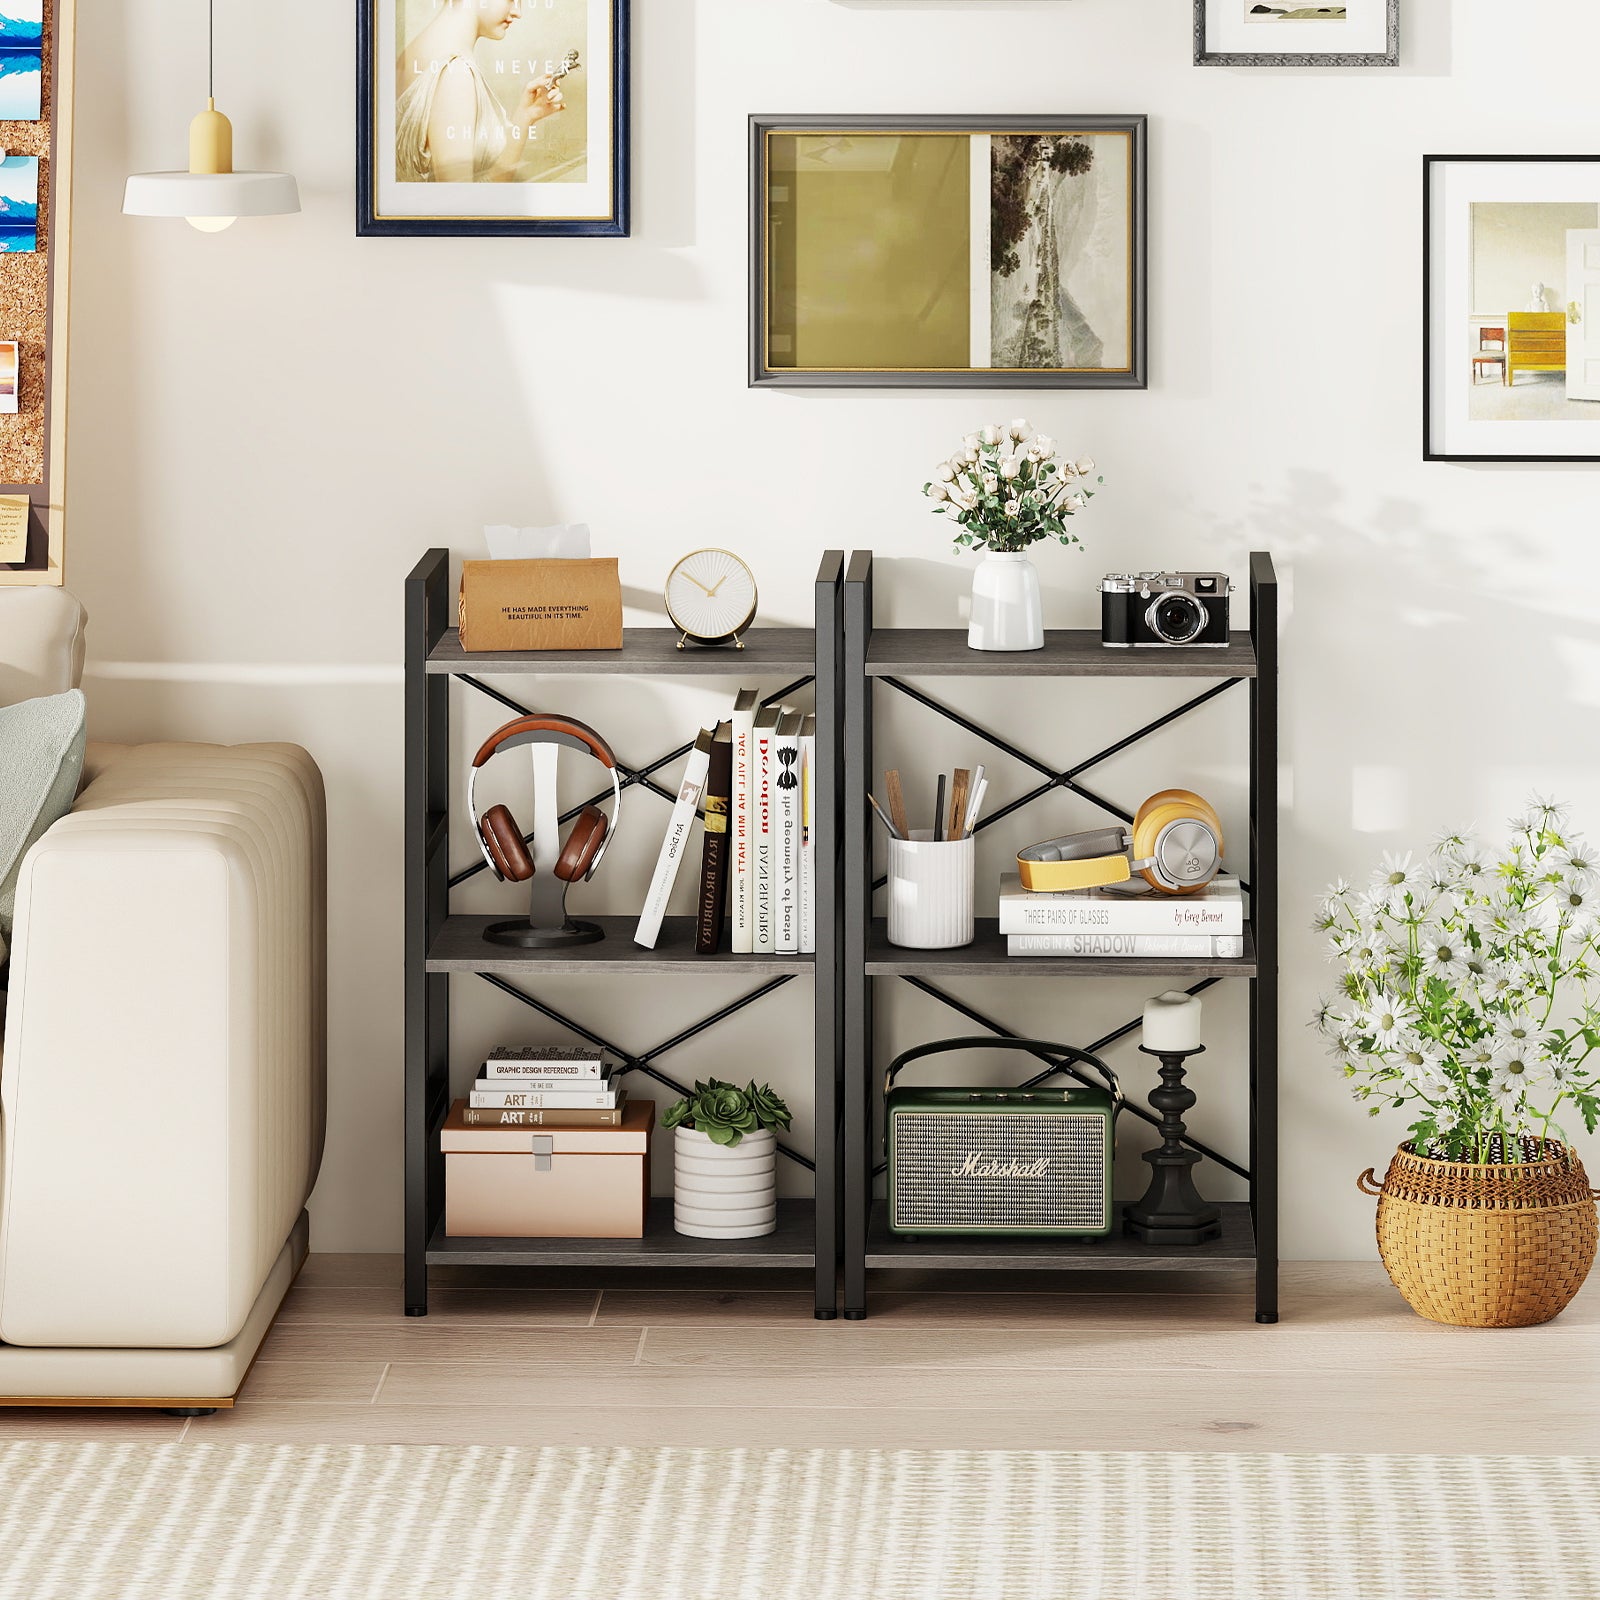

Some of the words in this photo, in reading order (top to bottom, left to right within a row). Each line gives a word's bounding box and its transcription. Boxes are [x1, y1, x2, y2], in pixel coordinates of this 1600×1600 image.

[495, 60, 570, 74] NEVER
[446, 125, 537, 140] CHANGE
[1024, 909, 1045, 924] THREE
[1047, 909, 1066, 924] PAIRS
[1068, 909, 1077, 924] OF
[1079, 909, 1109, 925] GLASSES
[1020, 935, 1050, 950] LIVING
[1053, 935, 1062, 950] IN
[1064, 935, 1072, 950] A
[1073, 935, 1136, 954] SHADOW
[496, 1066, 521, 1074] GRAPHIC
[522, 1066, 542, 1074] DESIGN
[543, 1066, 579, 1074] REFERENCED
[504, 1094, 527, 1106] ART
[500, 1111, 525, 1124] ART
[951, 1150, 1051, 1177] Marshall
